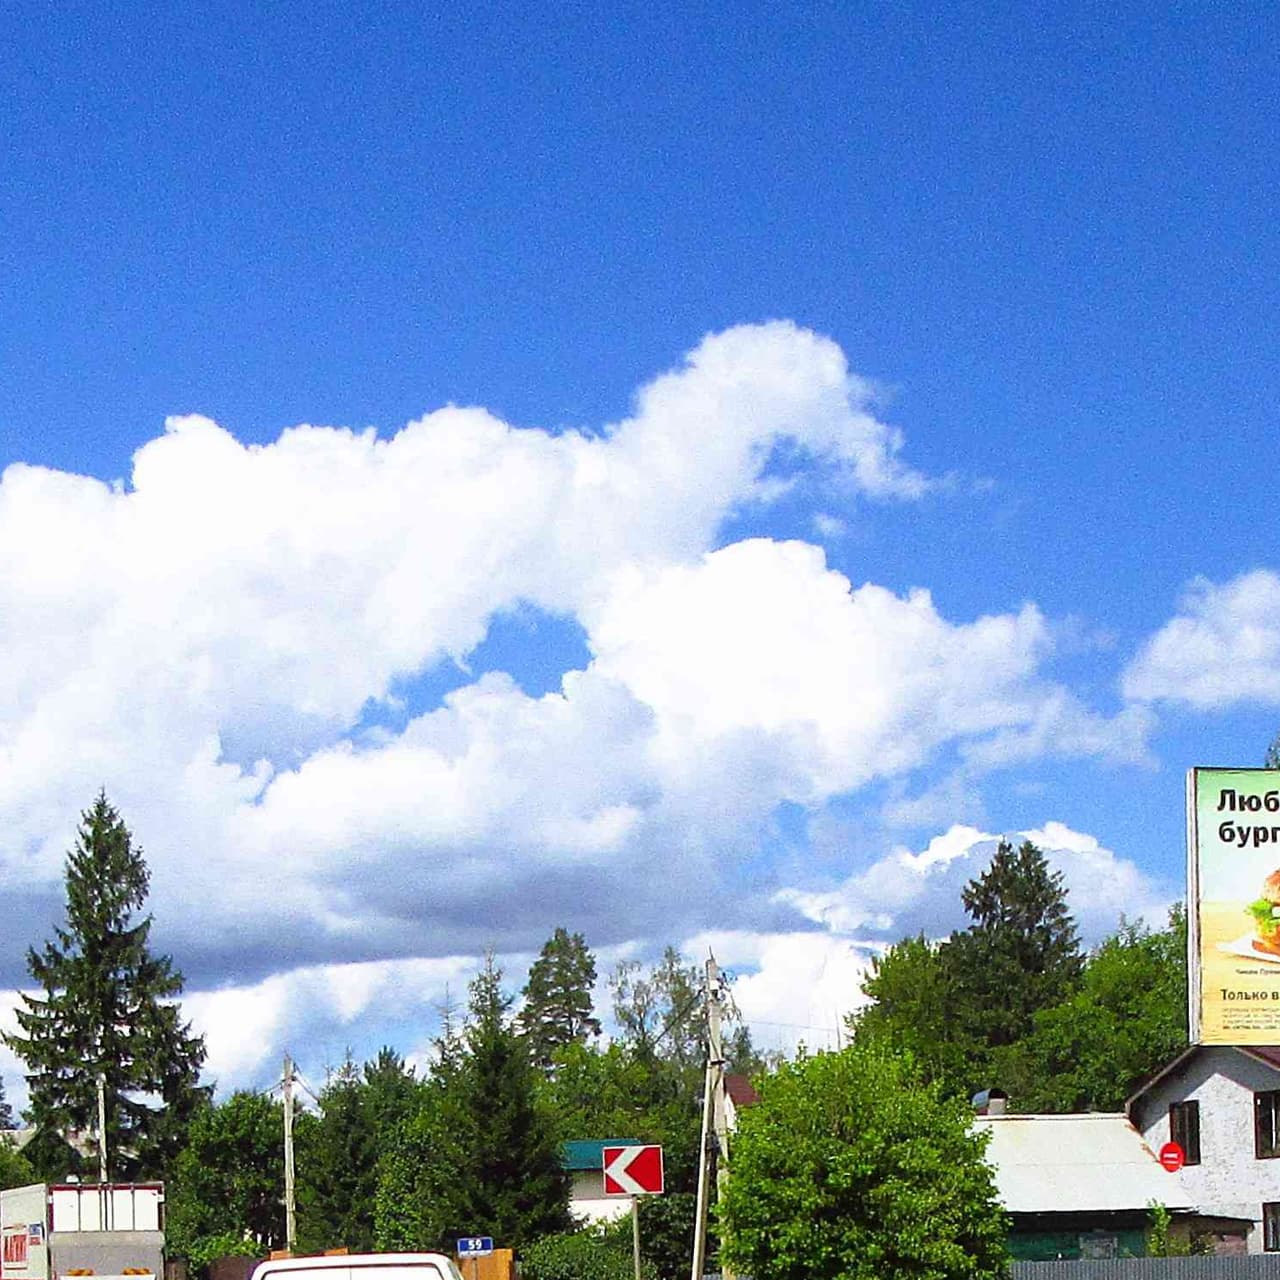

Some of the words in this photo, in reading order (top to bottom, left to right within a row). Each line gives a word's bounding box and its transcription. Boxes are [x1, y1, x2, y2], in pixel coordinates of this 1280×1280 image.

[1220, 989, 1268, 1001] Только
[1271, 991, 1280, 1001] в
[468, 1239, 482, 1250] 59
